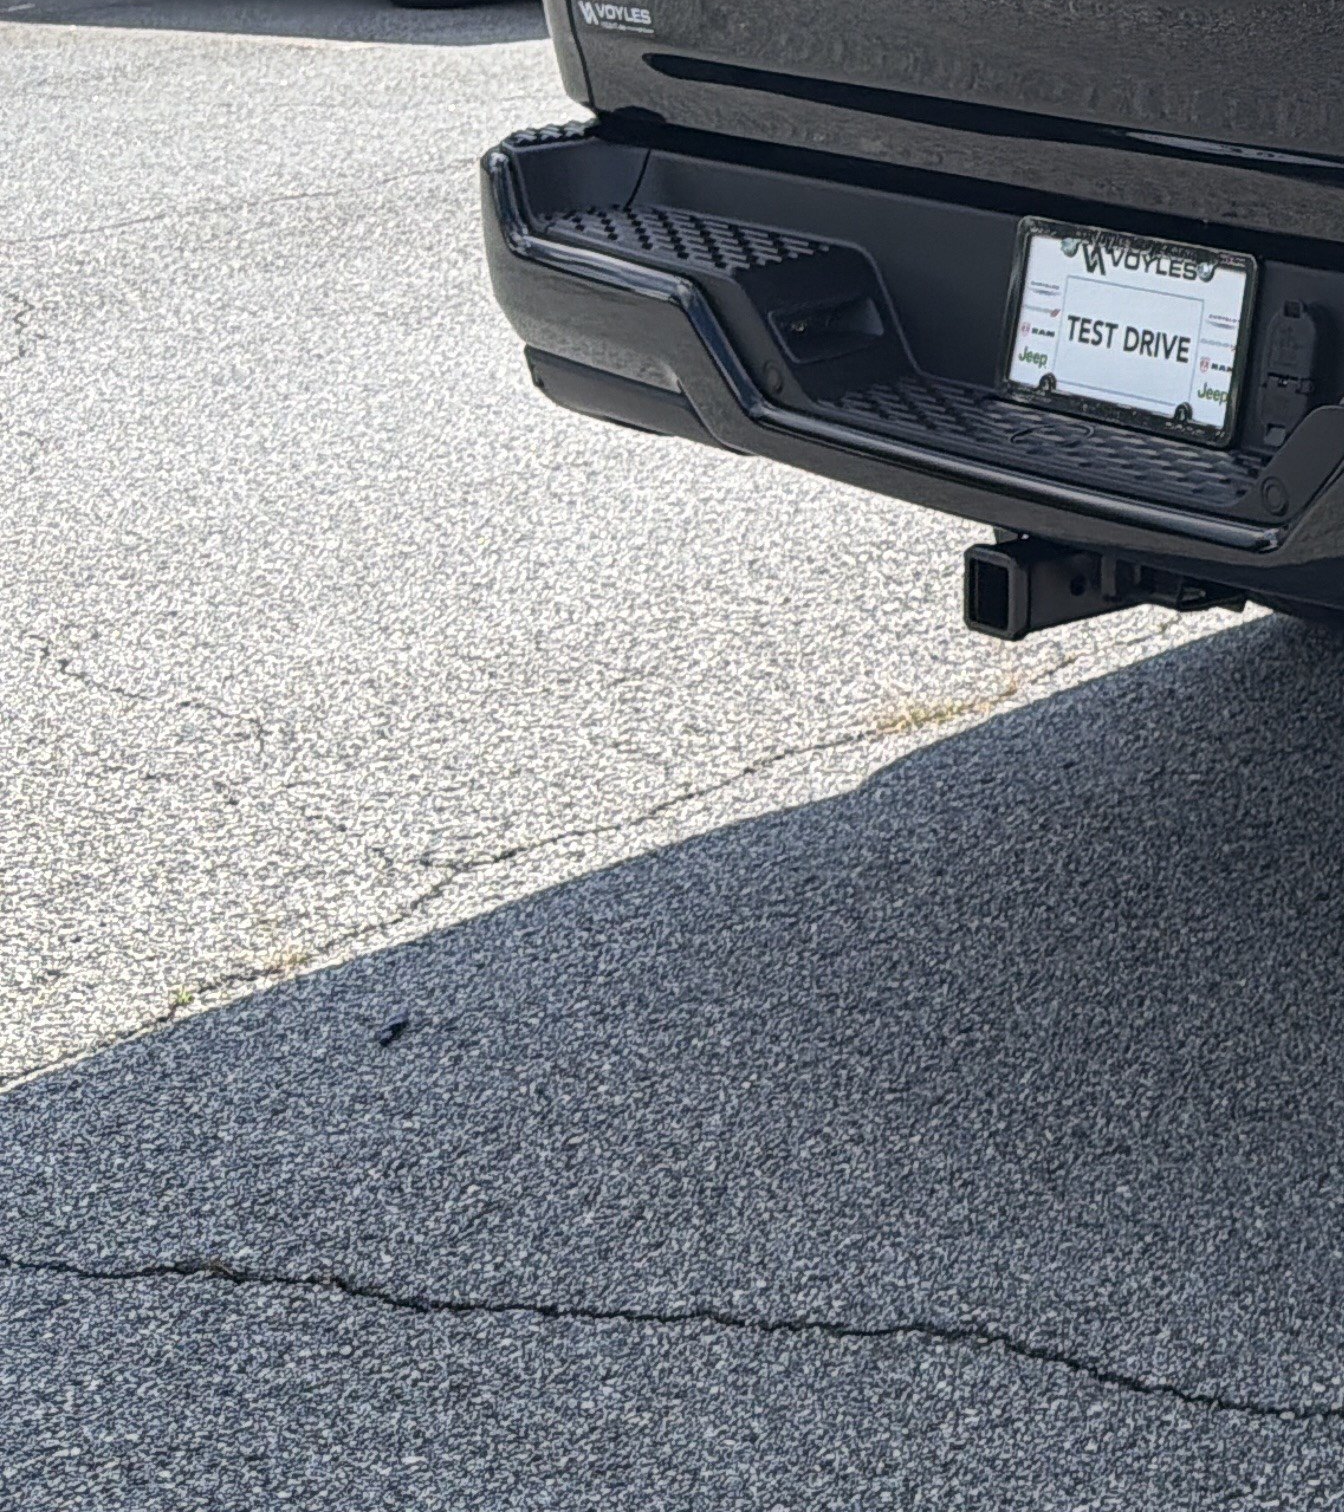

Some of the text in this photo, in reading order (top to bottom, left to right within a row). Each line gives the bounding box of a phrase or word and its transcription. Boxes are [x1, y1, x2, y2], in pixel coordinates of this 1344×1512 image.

[594, 2, 652, 25] VOYLES
[1105, 245, 1199, 281] VOYLES
[1067, 314, 1192, 364] TEST DRIVE
[1018, 346, 1049, 369] Jeep
[1197, 382, 1231, 406] Jeep
